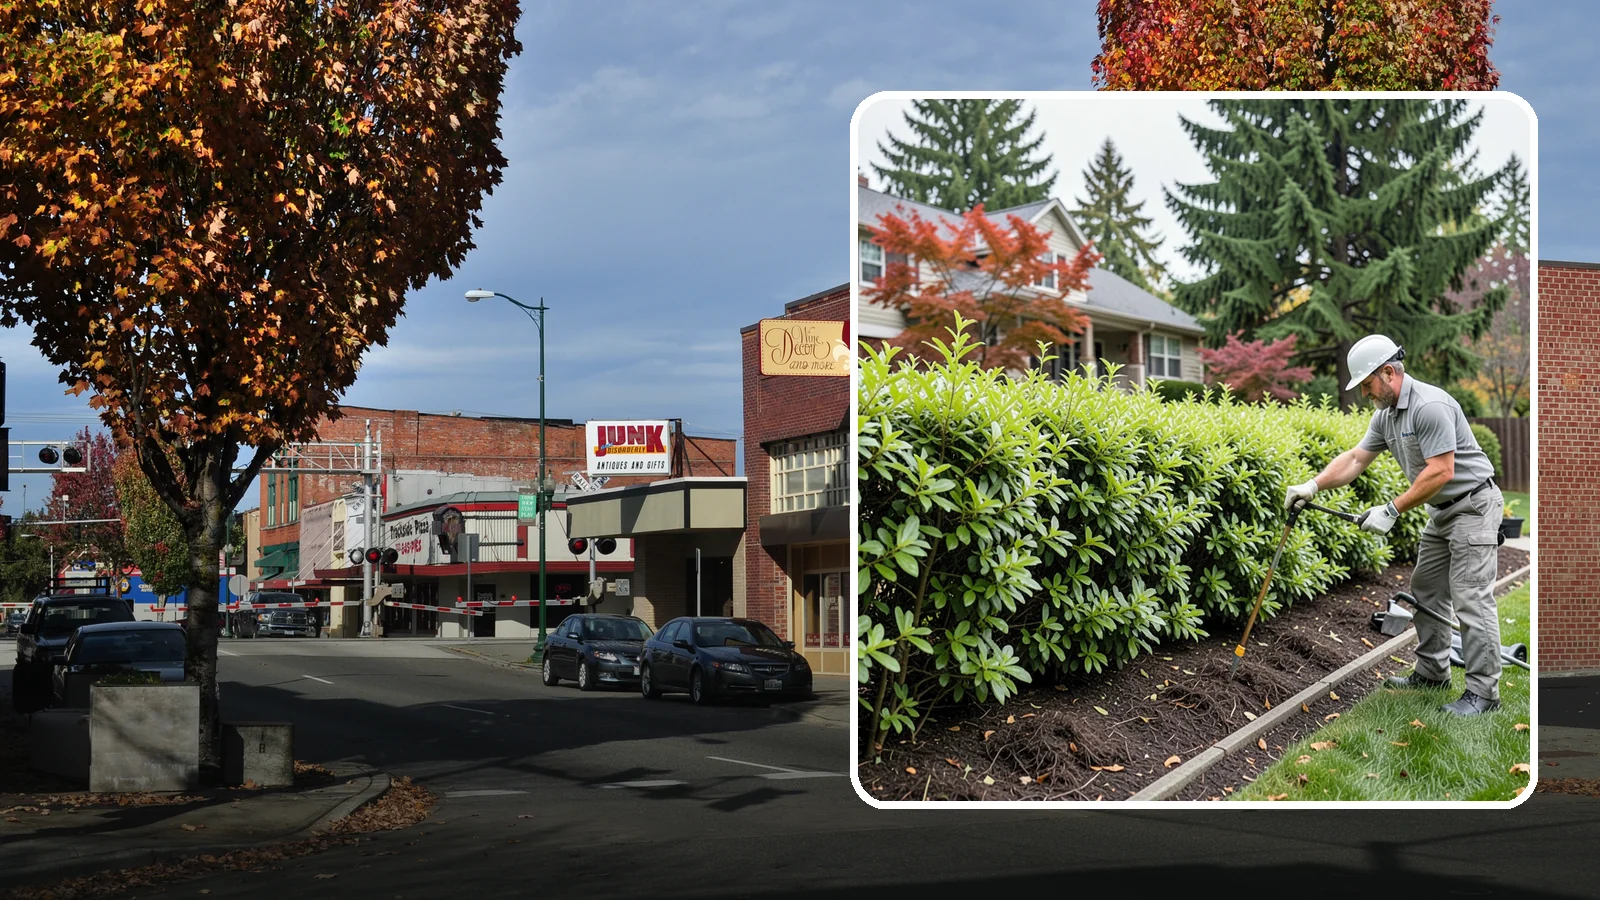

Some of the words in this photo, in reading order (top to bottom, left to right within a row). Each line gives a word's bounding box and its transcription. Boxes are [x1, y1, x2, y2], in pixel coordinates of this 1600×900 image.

[765, 328, 830, 365] Decor
[596, 425, 665, 457] JUNK
[608, 446, 645, 454] DISORDERLY
[597, 461, 628, 470] ANTIQUES
[631, 461, 644, 470] AND
[647, 461, 665, 469] GIFTS
[390, 520, 413, 540] Trackside
[414, 519, 429, 535] Pizza
